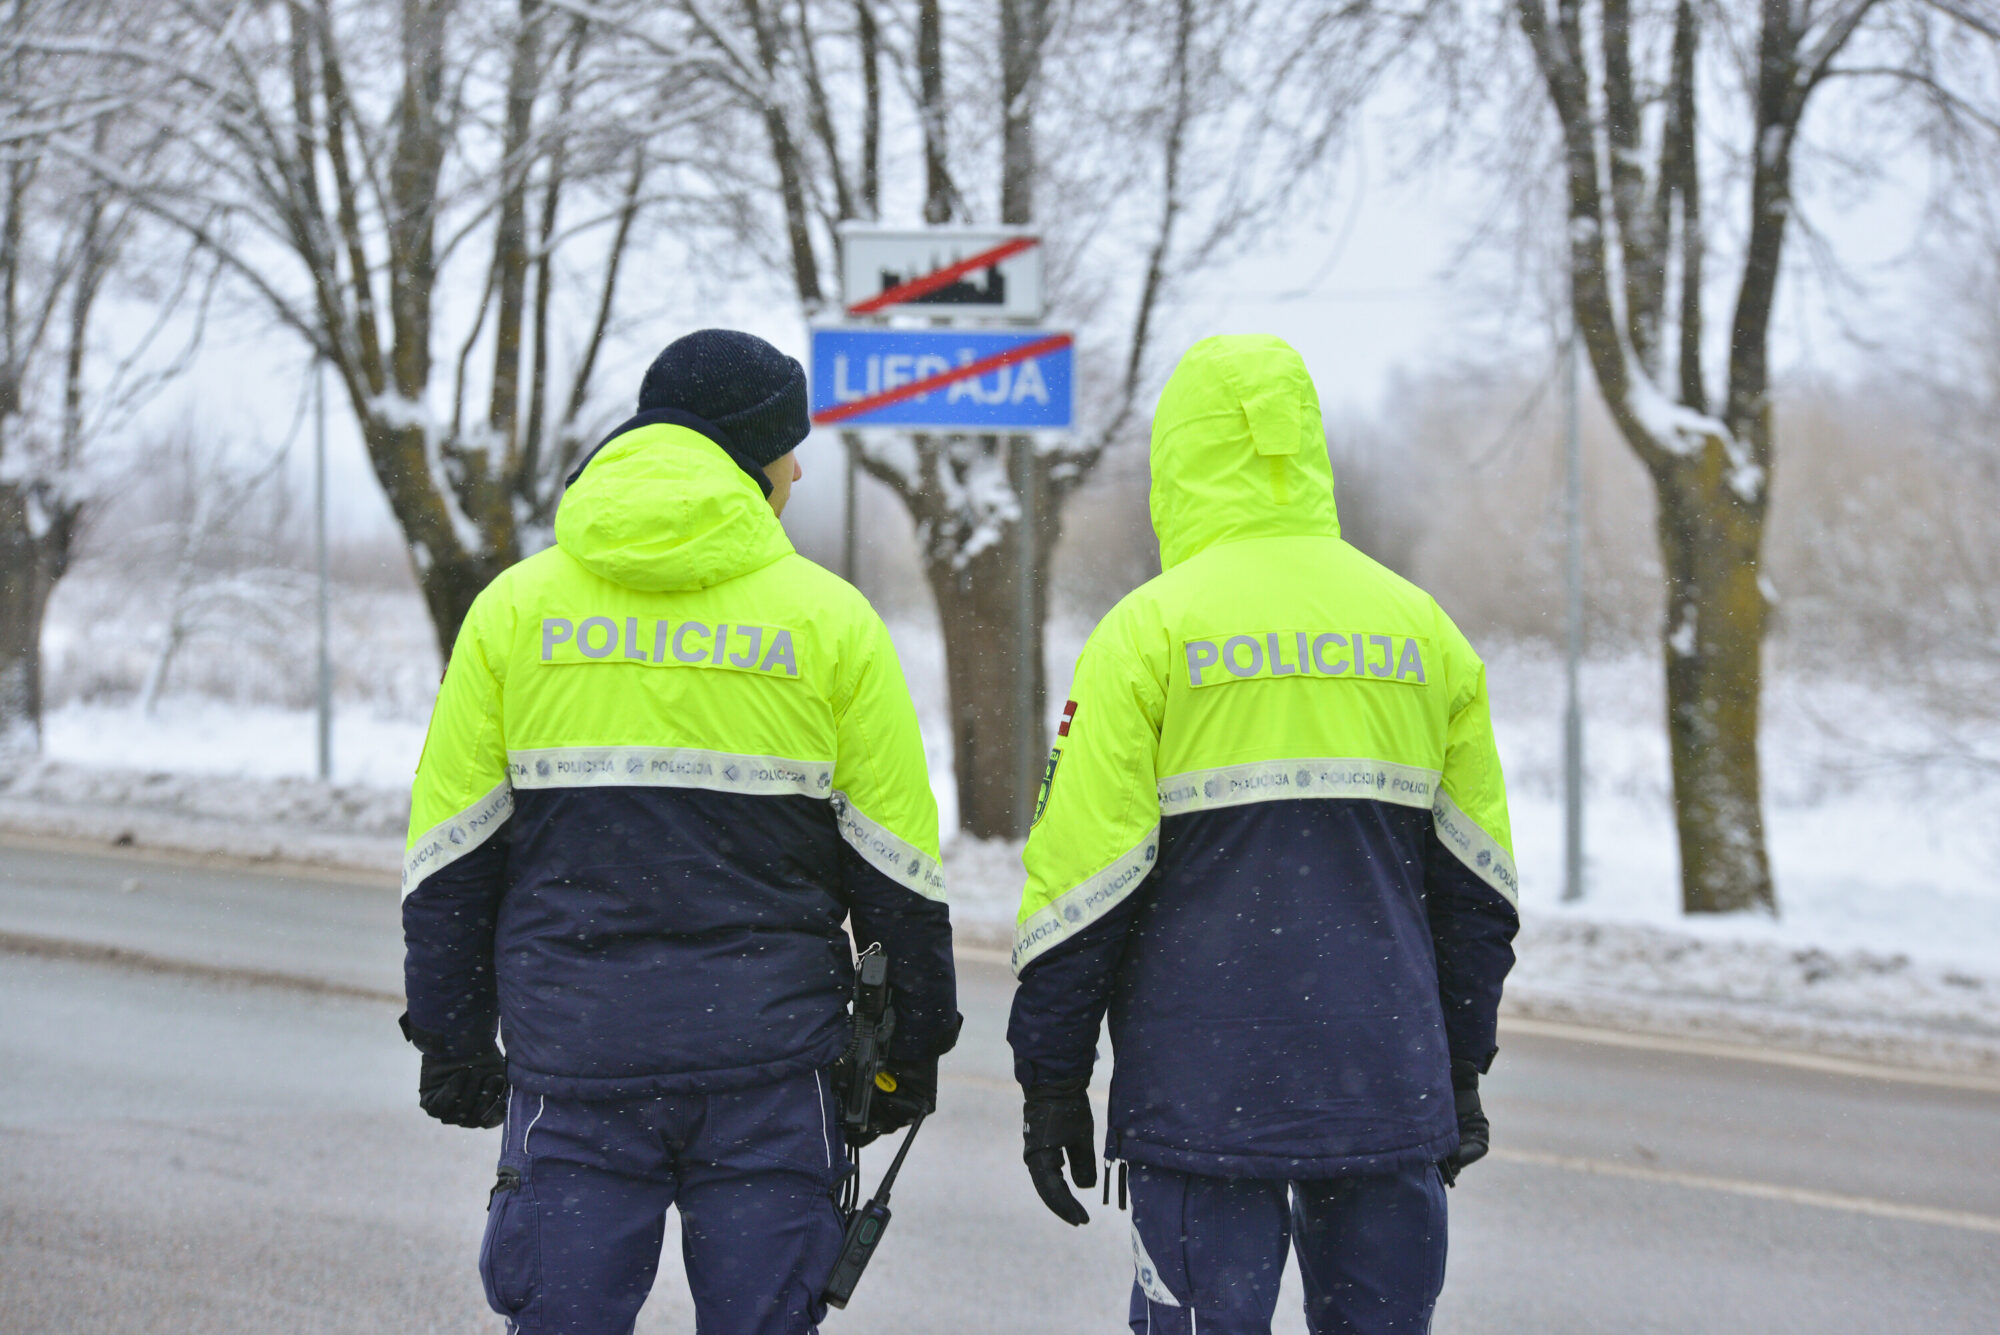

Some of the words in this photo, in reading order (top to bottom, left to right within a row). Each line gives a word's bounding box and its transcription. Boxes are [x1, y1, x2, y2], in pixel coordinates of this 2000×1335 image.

[542, 616, 798, 676] POLICIJA
[1186, 632, 1426, 685] POLICIJA
[1085, 865, 1141, 908] POLICIJA
